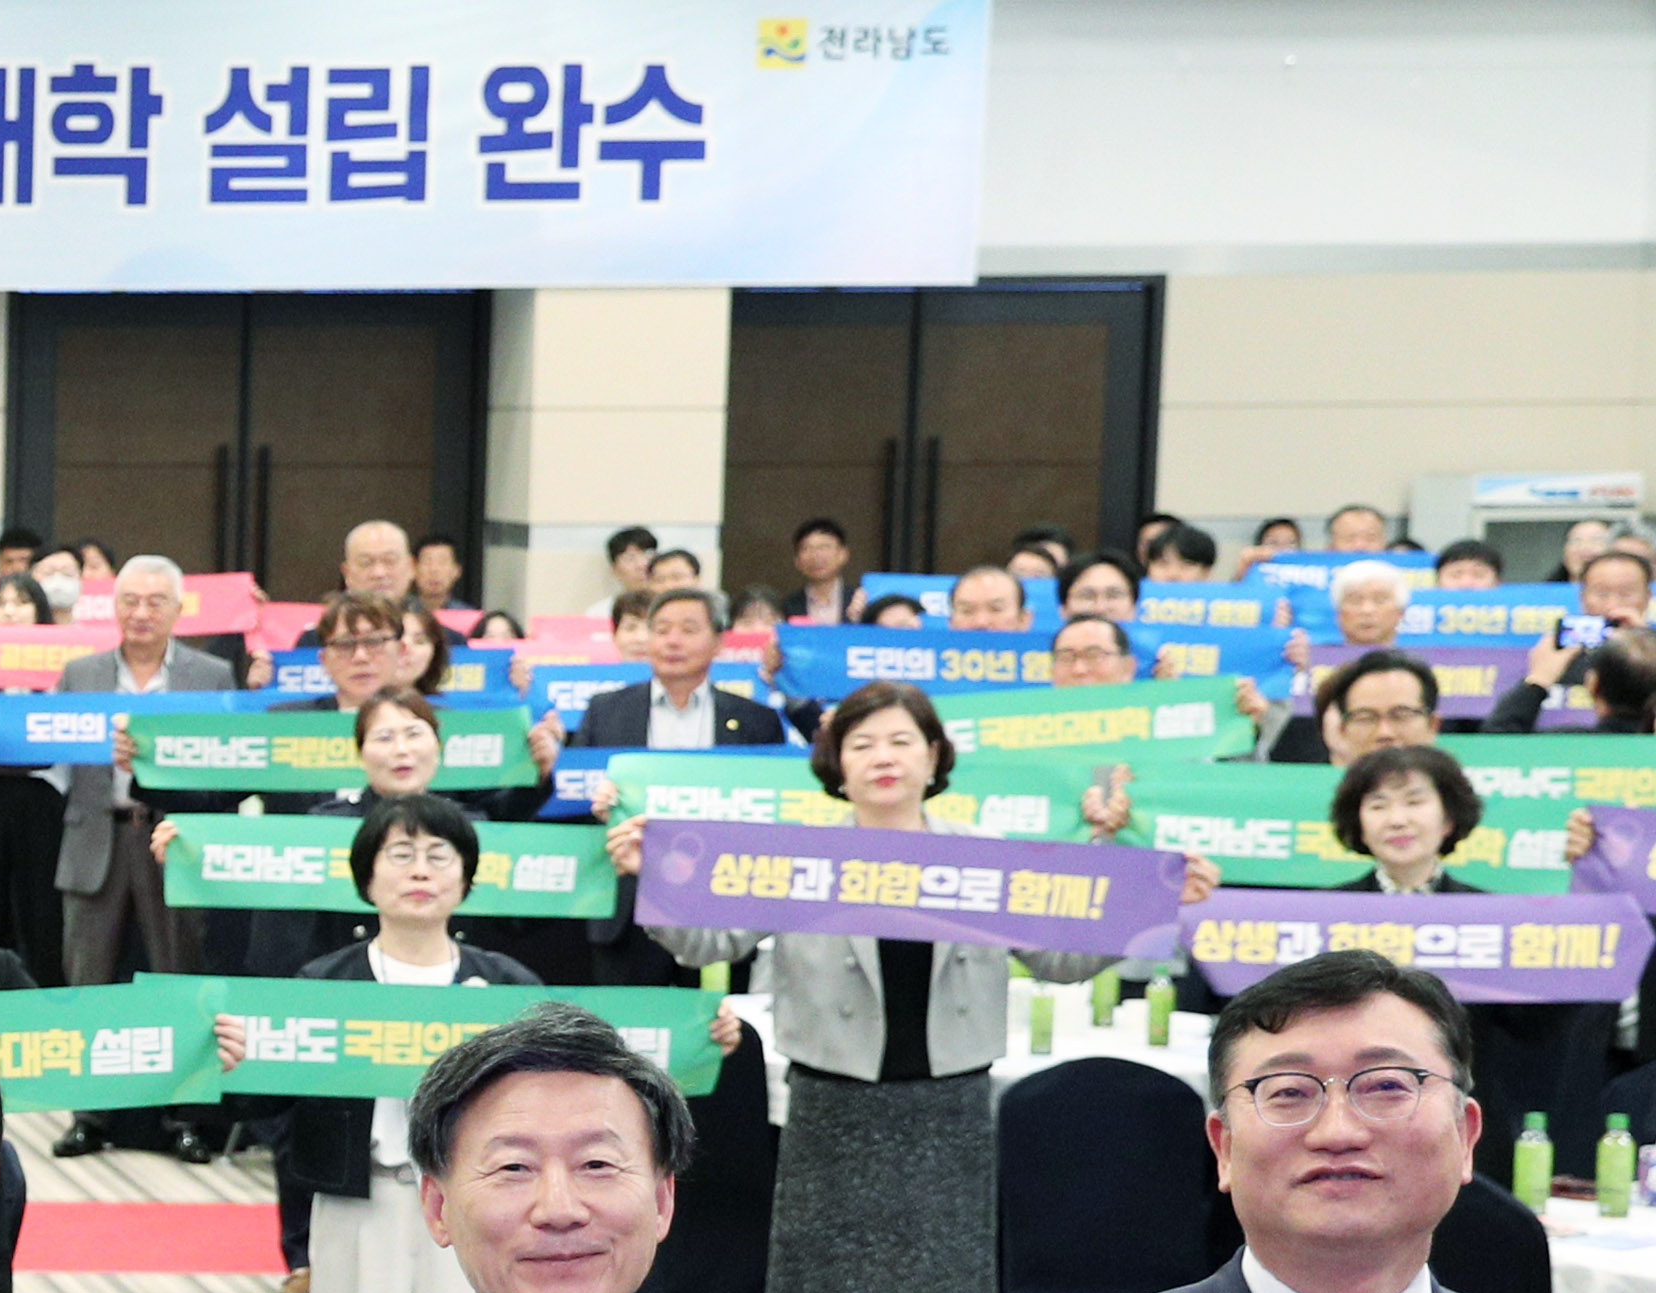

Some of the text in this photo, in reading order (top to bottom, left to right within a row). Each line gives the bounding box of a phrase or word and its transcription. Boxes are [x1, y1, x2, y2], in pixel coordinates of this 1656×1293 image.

[818, 23, 952, 61] 전라남도
[204, 63, 432, 205] 설립
[476, 63, 708, 203] 완수
[277, 665, 337, 693] 도민
[846, 646, 937, 681] 도민의
[940, 649, 1017, 682] 30년
[26, 712, 106, 743] 도민의
[155, 735, 269, 769] 전라남도
[646, 785, 777, 823] 전라남도
[1155, 815, 1292, 859] 전라남도
[202, 843, 324, 884] 전라남도
[710, 852, 1110, 920] 상생과 화합으로 함께!
[1193, 920, 1323, 964] 상생과
[1510, 922, 1622, 969] 함께!
[90, 1026, 173, 1076] 설립
[243, 1016, 338, 1064] 남도
[344, 1019, 496, 1067] 국립의
